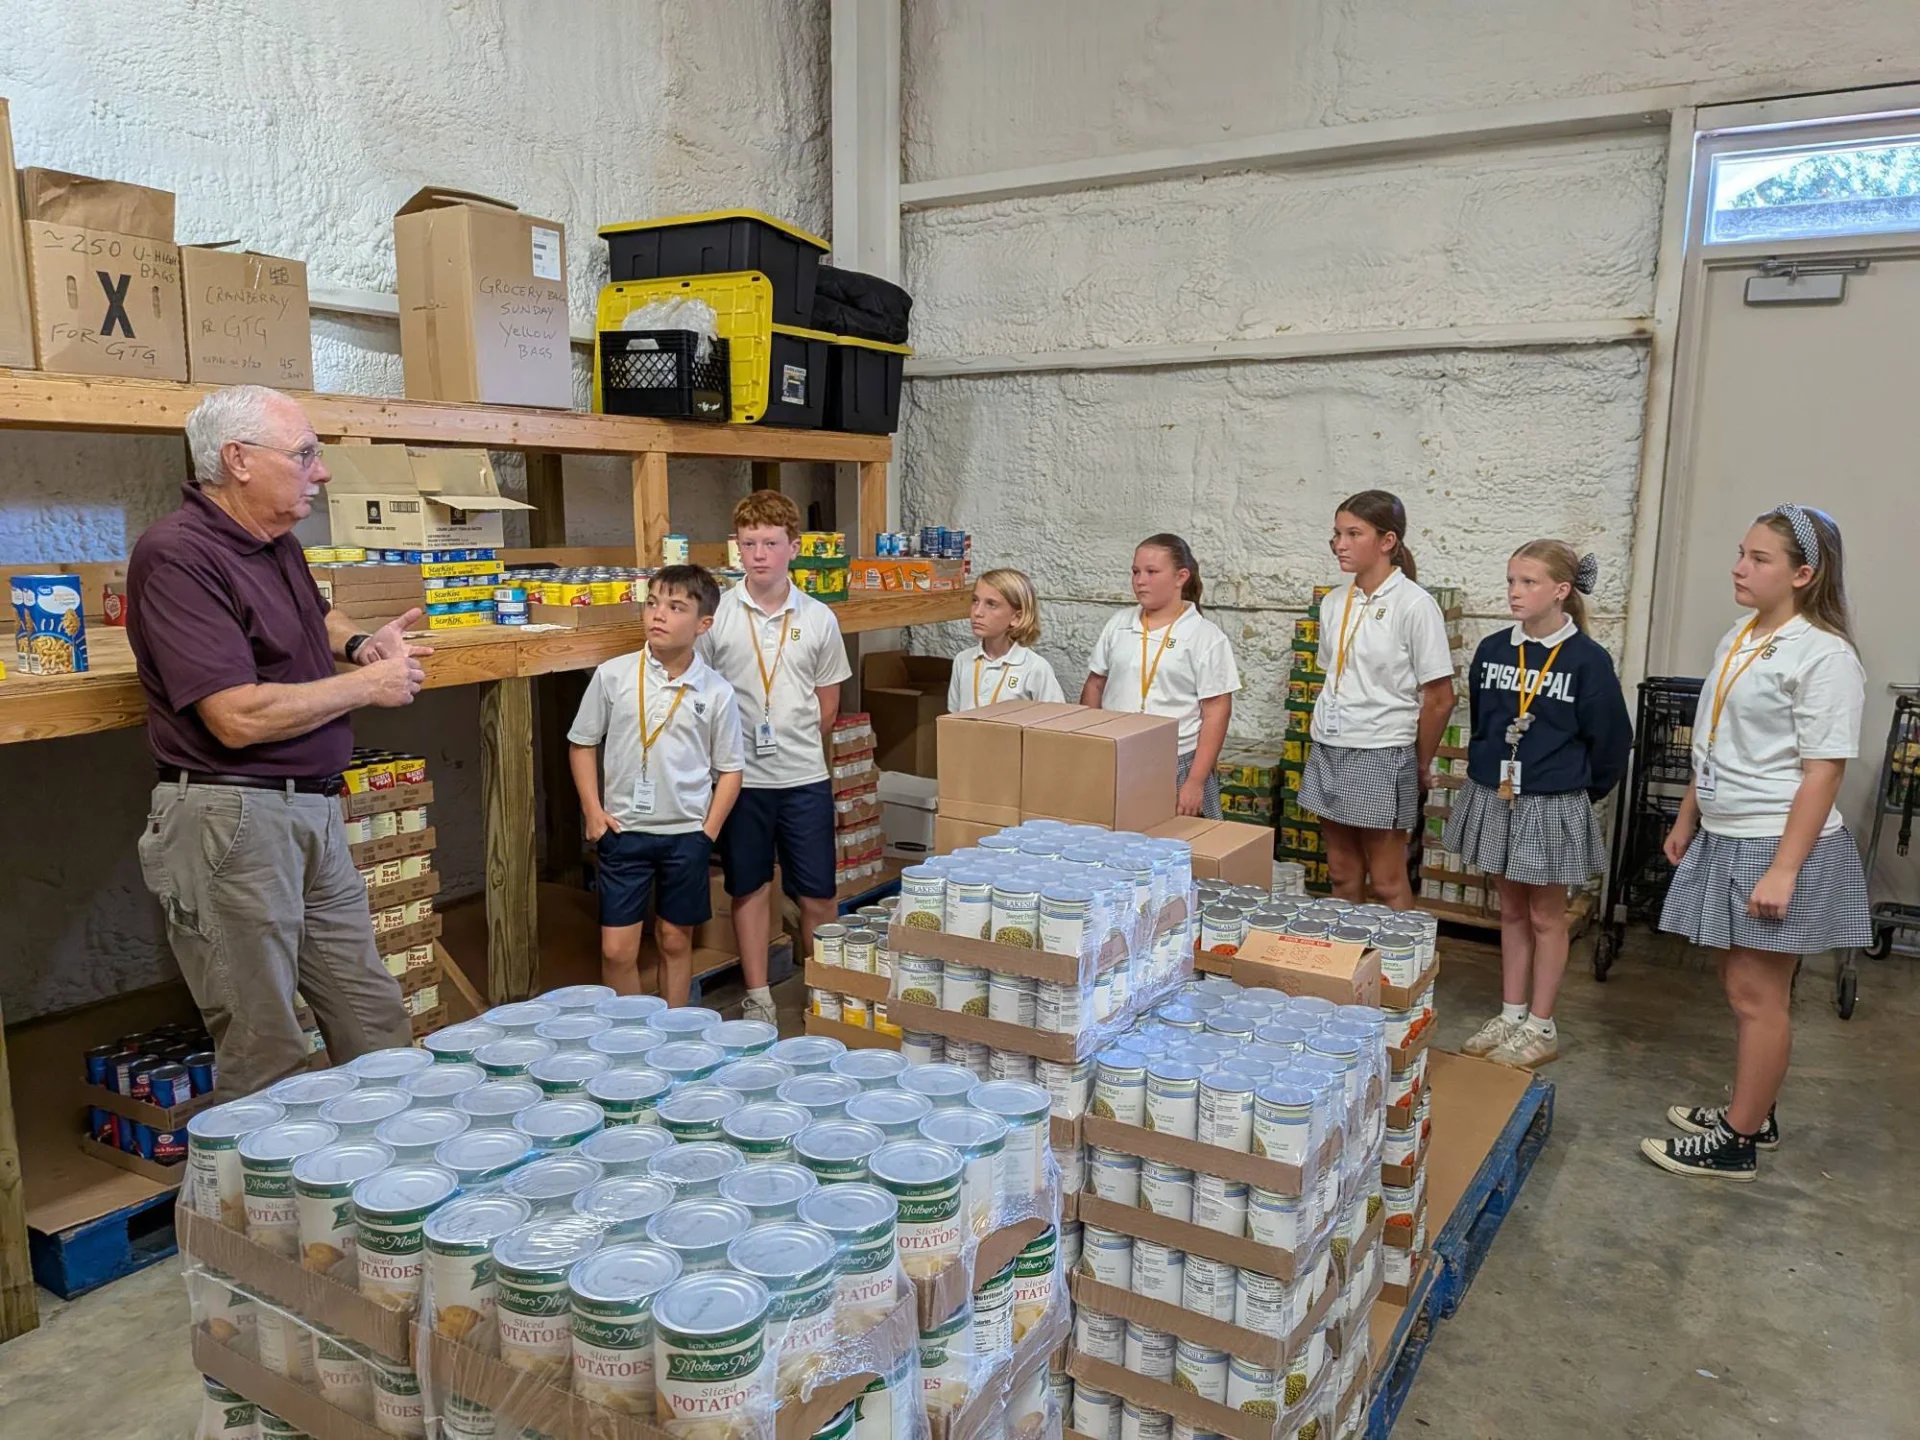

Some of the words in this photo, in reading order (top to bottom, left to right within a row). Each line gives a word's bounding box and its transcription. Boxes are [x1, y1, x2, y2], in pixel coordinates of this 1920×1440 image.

[71, 234, 122, 258] 250
[140, 263, 175, 284] BAGS
[479, 276, 543, 302] GROCERY
[205, 286, 290, 321] CRANBERRY
[500, 302, 554, 324] SUNDAY
[223, 314, 269, 350] GTG
[51, 322, 99, 345] FOR
[105, 341, 156, 366] GTG
[518, 343, 552, 360] BAGS
[279, 358, 297, 370] 45
[428, 564, 455, 573] StarKist
[434, 590, 460, 599] StarKist
[435, 615, 464, 626] StarKist
[790, 627, 802, 642] E
[382, 869, 400, 878] Red
[420, 862, 431, 871] Re
[384, 912, 404, 922] Red
[408, 952, 428, 962] Red
[247, 1177, 286, 1191] Mother's
[897, 1202, 938, 1216] Mother's
[916, 1224, 944, 1236] Sliced
[382, 1232, 422, 1250] Maid
[367, 1255, 394, 1266] Sliced
[514, 1318, 545, 1329] Sliced
[574, 1315, 612, 1339] Mother's
[688, 1342, 706, 1350] LOW
[707, 1337, 738, 1349] SODIUM
[589, 1351, 621, 1363] Sliced
[671, 1357, 729, 1376] Mother's
[700, 1382, 738, 1398] Sliced
